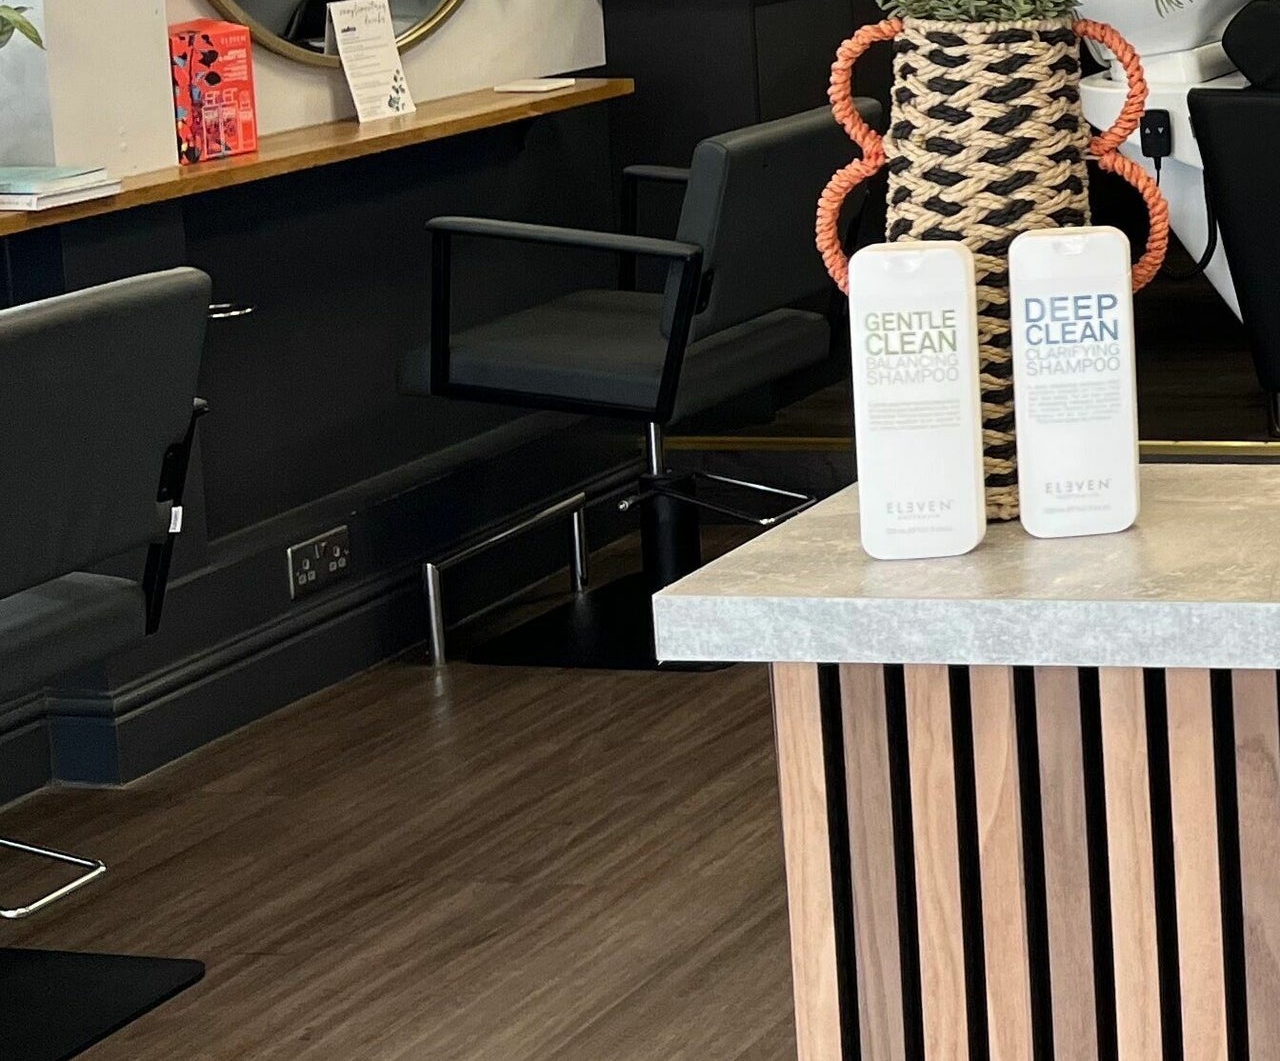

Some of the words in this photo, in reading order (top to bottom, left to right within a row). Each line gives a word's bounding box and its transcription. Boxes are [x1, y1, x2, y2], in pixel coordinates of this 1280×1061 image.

[1025, 294, 1118, 323] DEEP
[865, 309, 956, 331] GENTLE
[866, 329, 957, 356] CLEAN
[1026, 319, 1119, 346] CLEAN
[866, 353, 959, 371] BALANCING
[1025, 342, 1120, 361] CLARIFYING
[867, 367, 959, 386] SHAMPOO
[1026, 356, 1120, 377] SHAMPOO
